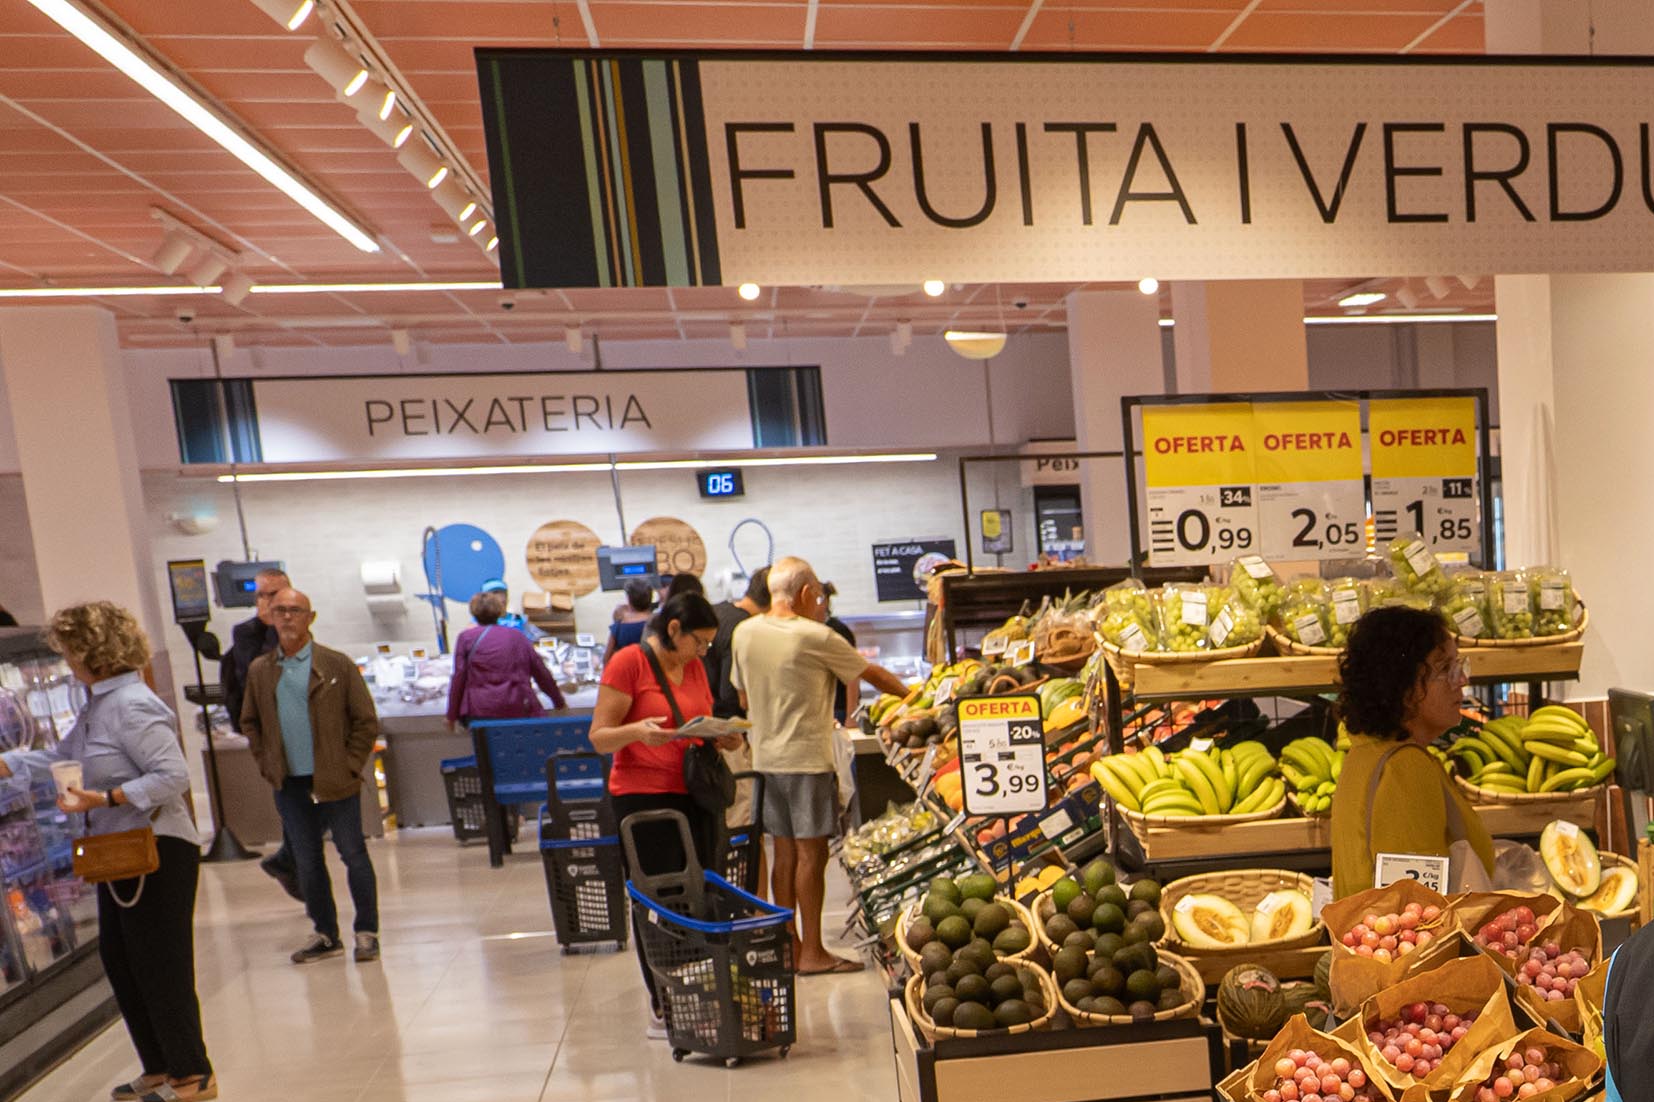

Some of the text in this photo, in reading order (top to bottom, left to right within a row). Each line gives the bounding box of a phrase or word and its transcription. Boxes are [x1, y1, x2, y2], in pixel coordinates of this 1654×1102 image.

[723, 121, 1198, 229] FRUITA
[1235, 121, 1252, 225] I
[364, 394, 652, 437] PEIXATERIA
[1153, 434, 1246, 455] OFERTA
[1263, 431, 1353, 451] OFERTA
[1379, 428, 1467, 447] OFERTA
[707, 473, 735, 494] 06
[1176, 508, 1252, 554] 0,99
[1291, 507, 1360, 550] 2,05
[965, 701, 1032, 716] OFERTA
[974, 763, 1039, 798] 3,99
